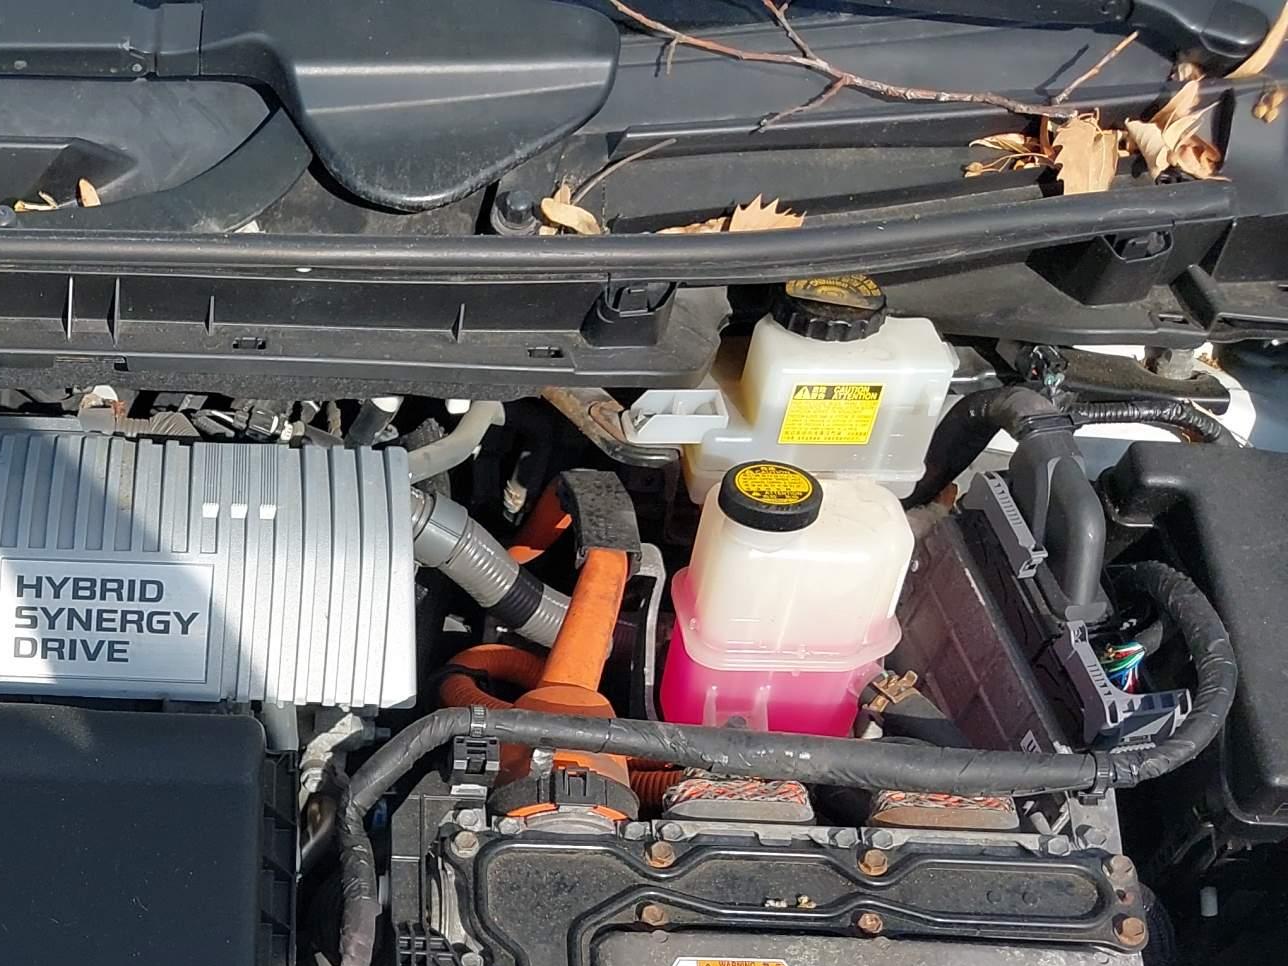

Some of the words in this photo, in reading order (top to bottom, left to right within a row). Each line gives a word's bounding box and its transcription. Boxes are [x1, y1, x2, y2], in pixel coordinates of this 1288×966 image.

[832, 392, 877, 400] ATTENTION
[16, 575, 165, 602] HYBRID
[14, 606, 199, 635] SYNERGY
[12, 638, 131, 663] DRIVE
